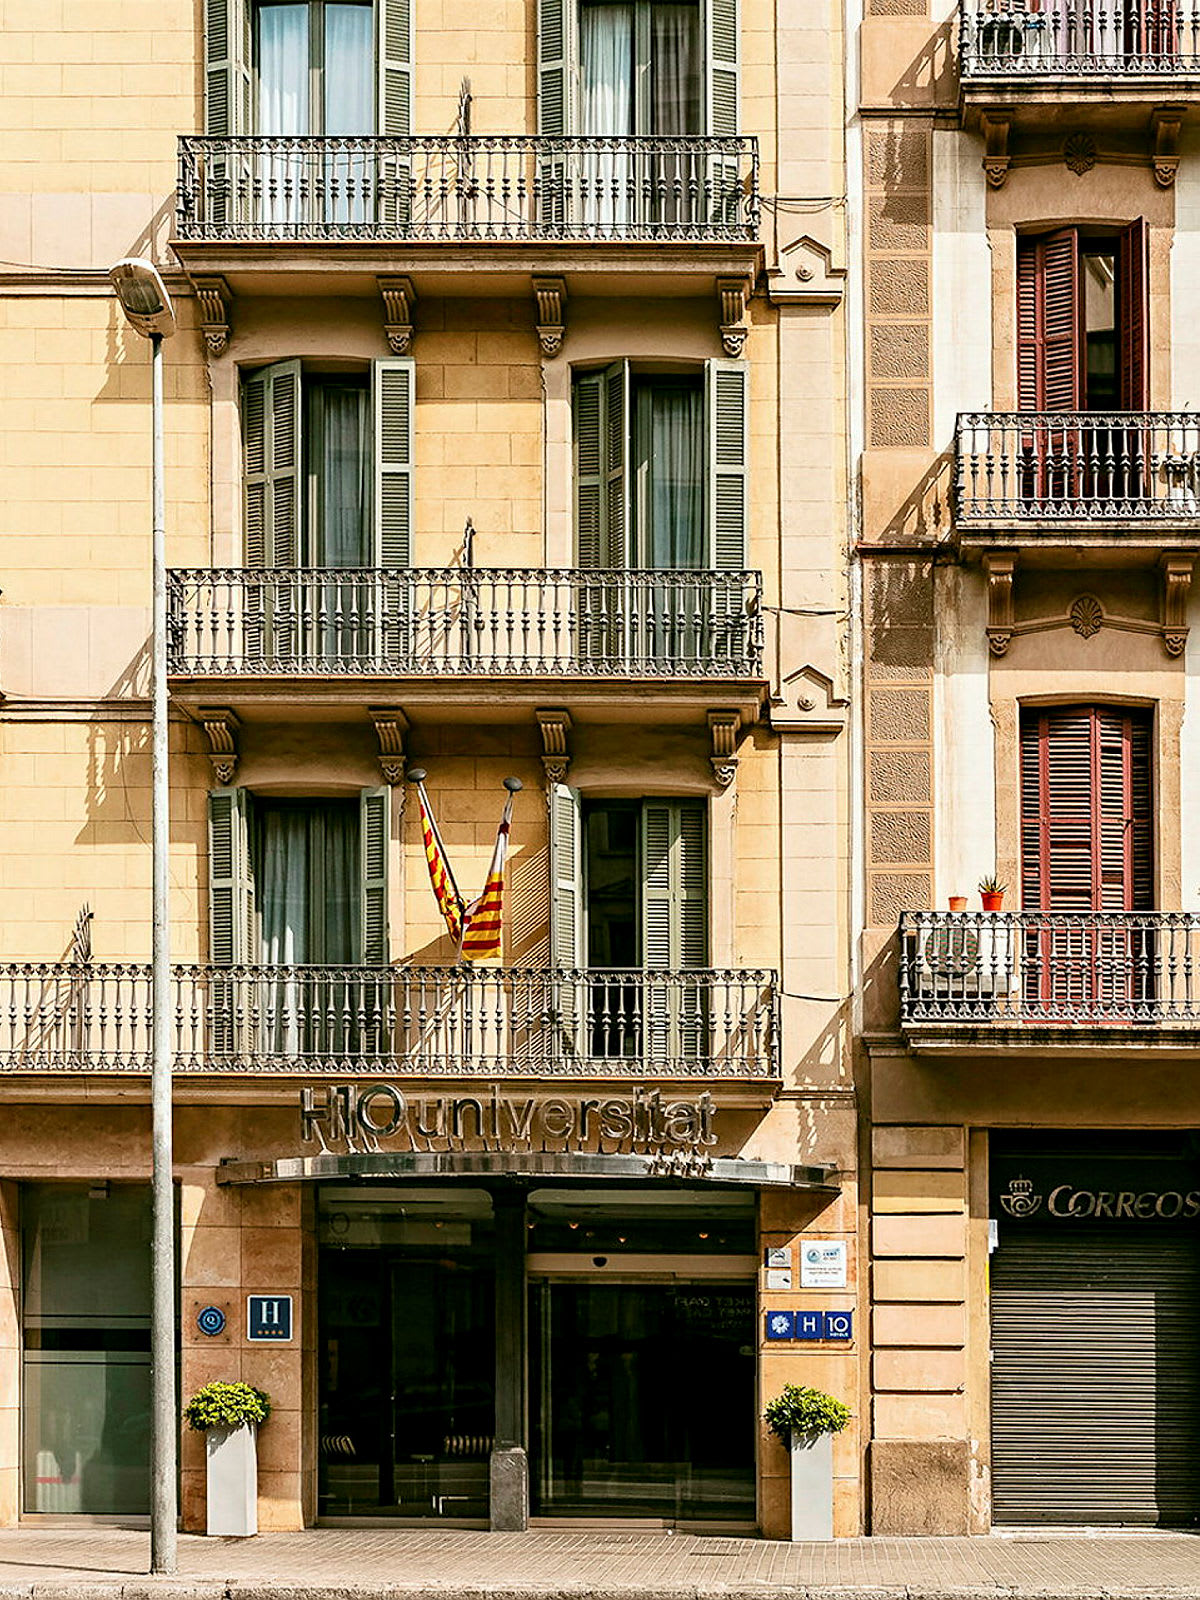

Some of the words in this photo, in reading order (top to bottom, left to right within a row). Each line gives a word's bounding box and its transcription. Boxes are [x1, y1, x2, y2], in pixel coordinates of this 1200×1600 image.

[414, 1083, 719, 1146] universitat
[1048, 1185, 1200, 1218] CORREOS
[261, 1301, 279, 1324] H
